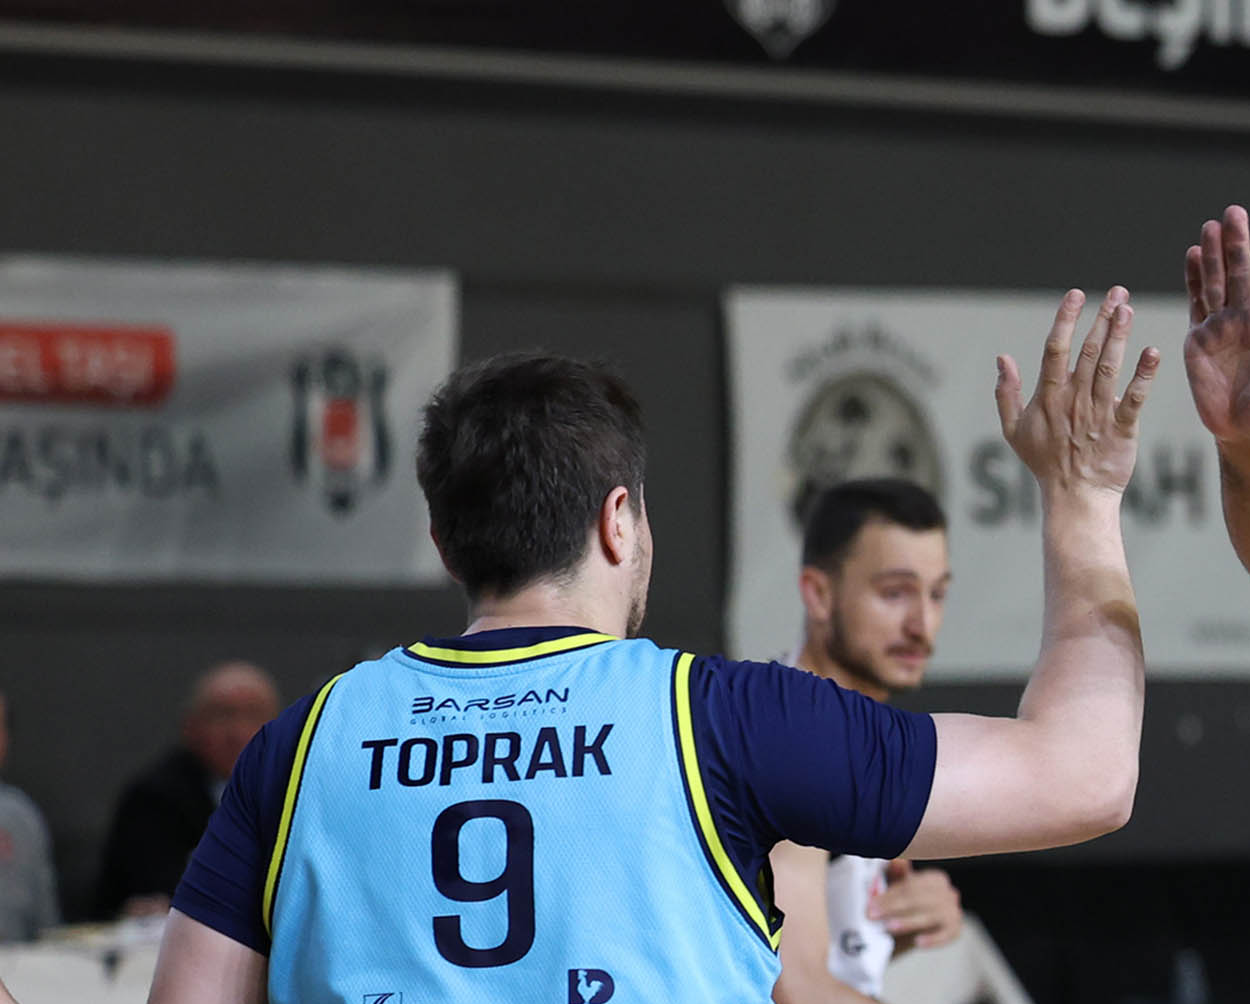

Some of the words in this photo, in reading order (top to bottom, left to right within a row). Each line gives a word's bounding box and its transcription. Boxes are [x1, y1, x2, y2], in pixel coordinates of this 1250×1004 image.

[411, 687, 569, 715] BARSAN
[361, 723, 615, 791] TOPRAK
[430, 798, 536, 969] 9
